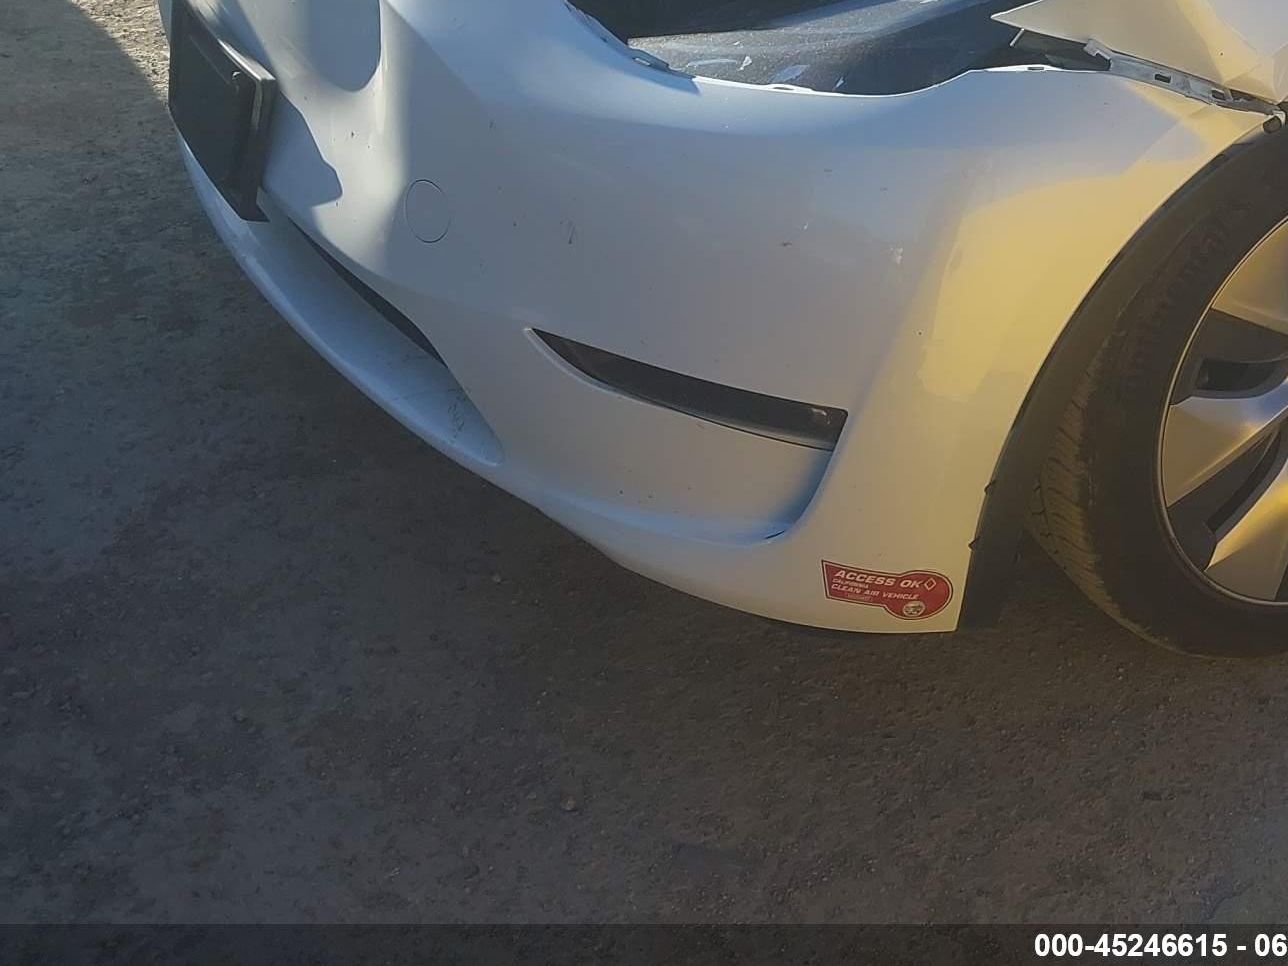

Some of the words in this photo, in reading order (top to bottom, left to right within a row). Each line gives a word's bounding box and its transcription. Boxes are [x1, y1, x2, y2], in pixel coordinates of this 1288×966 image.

[834, 570, 896, 586] ACCESS
[899, 579, 922, 588] OK
[831, 583, 861, 594] CLEAN
[882, 591, 920, 600] VEHICLE
